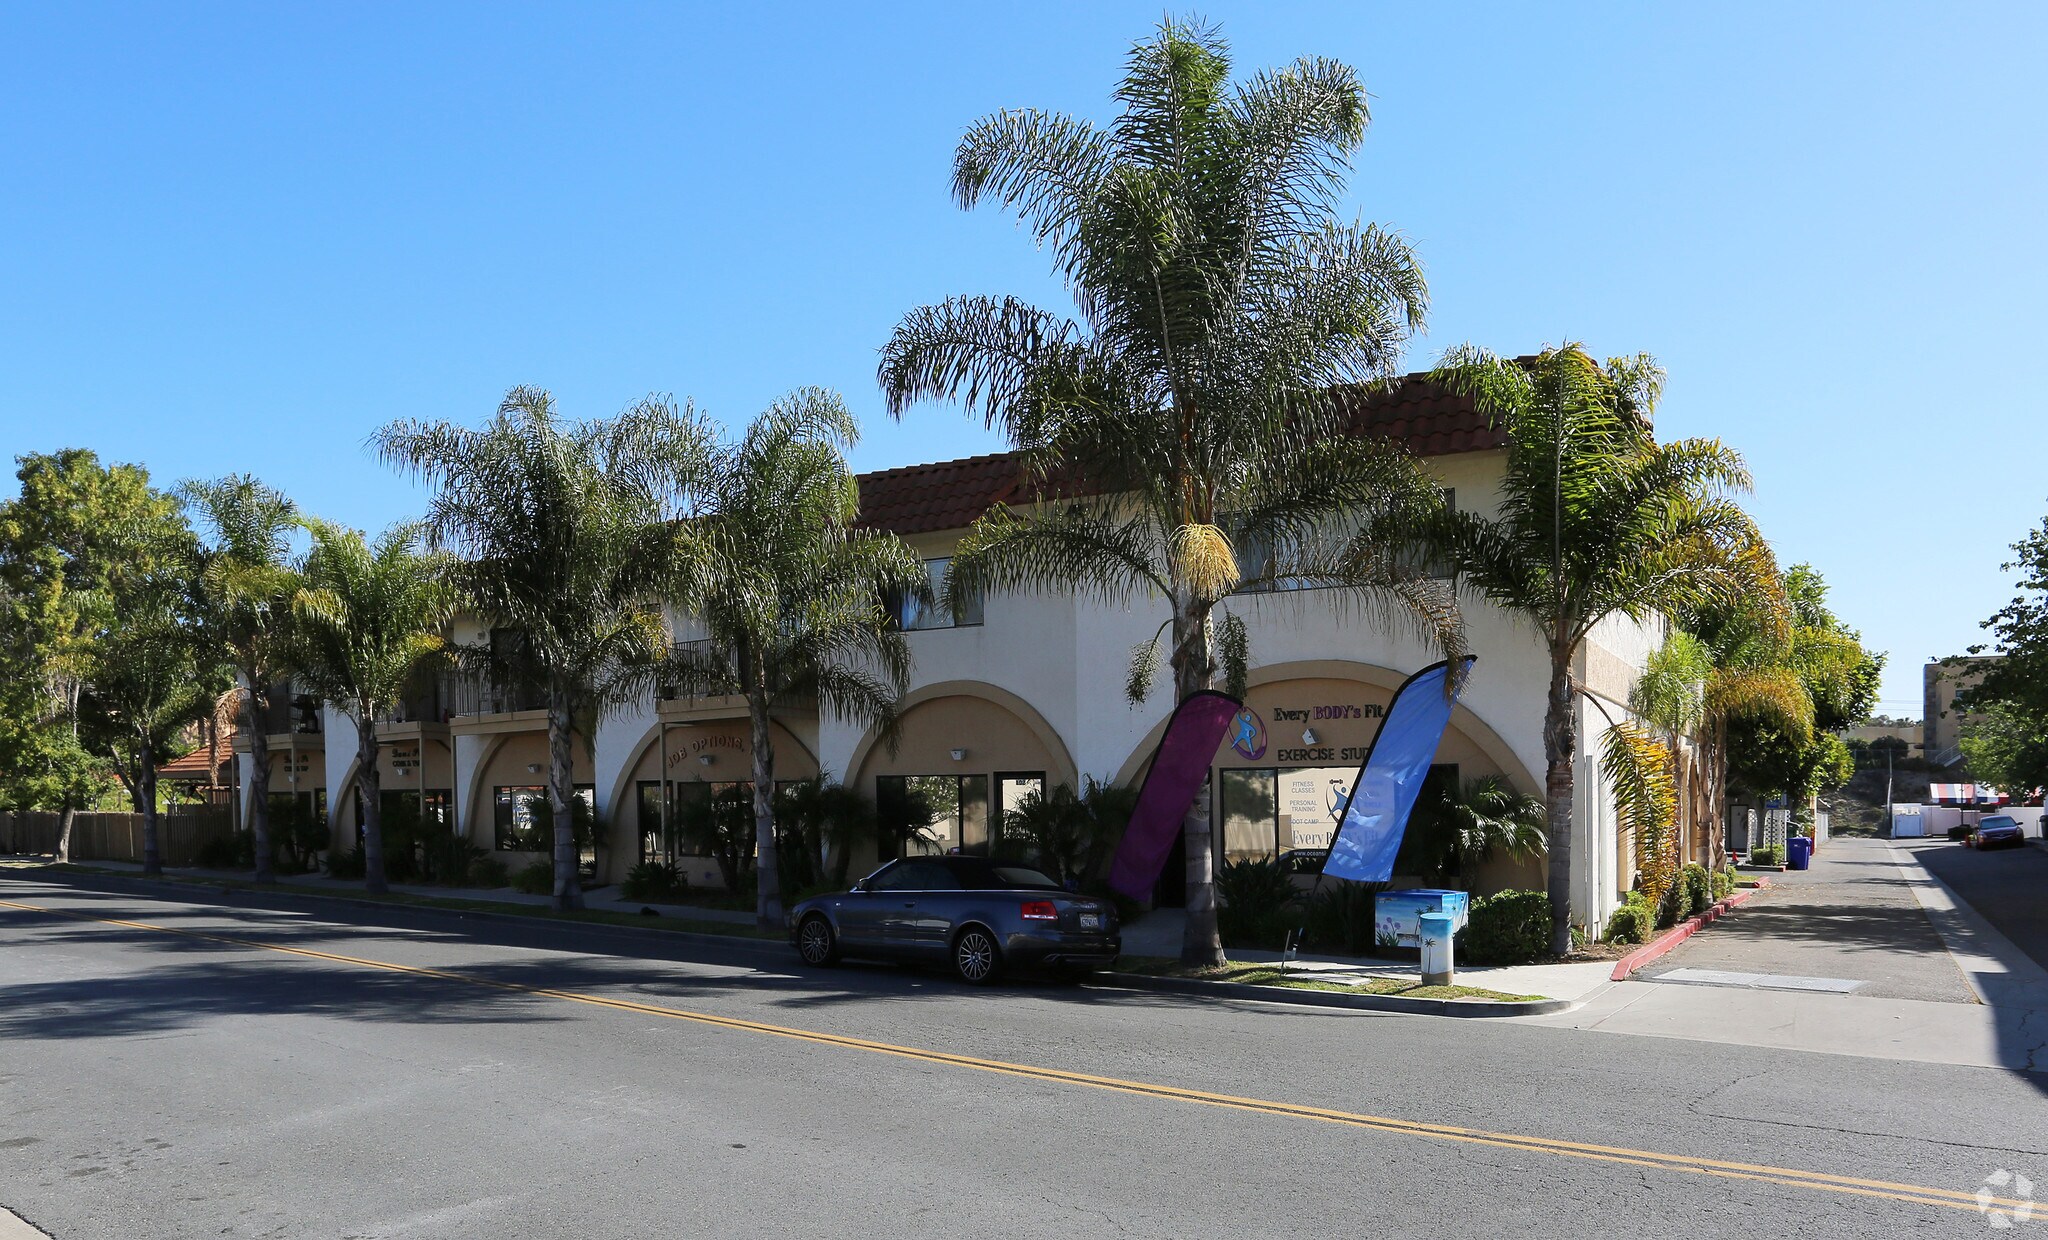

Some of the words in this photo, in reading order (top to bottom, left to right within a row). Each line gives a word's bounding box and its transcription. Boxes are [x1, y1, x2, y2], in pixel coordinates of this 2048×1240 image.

[1273, 706, 1311, 723] Every
[1313, 704, 1361, 720] BODY's
[1363, 703, 1384, 719] Fit
[668, 746, 687, 768] JOB
[1277, 747, 1335, 762] EXERCISE
[1293, 830, 1324, 848] Every
